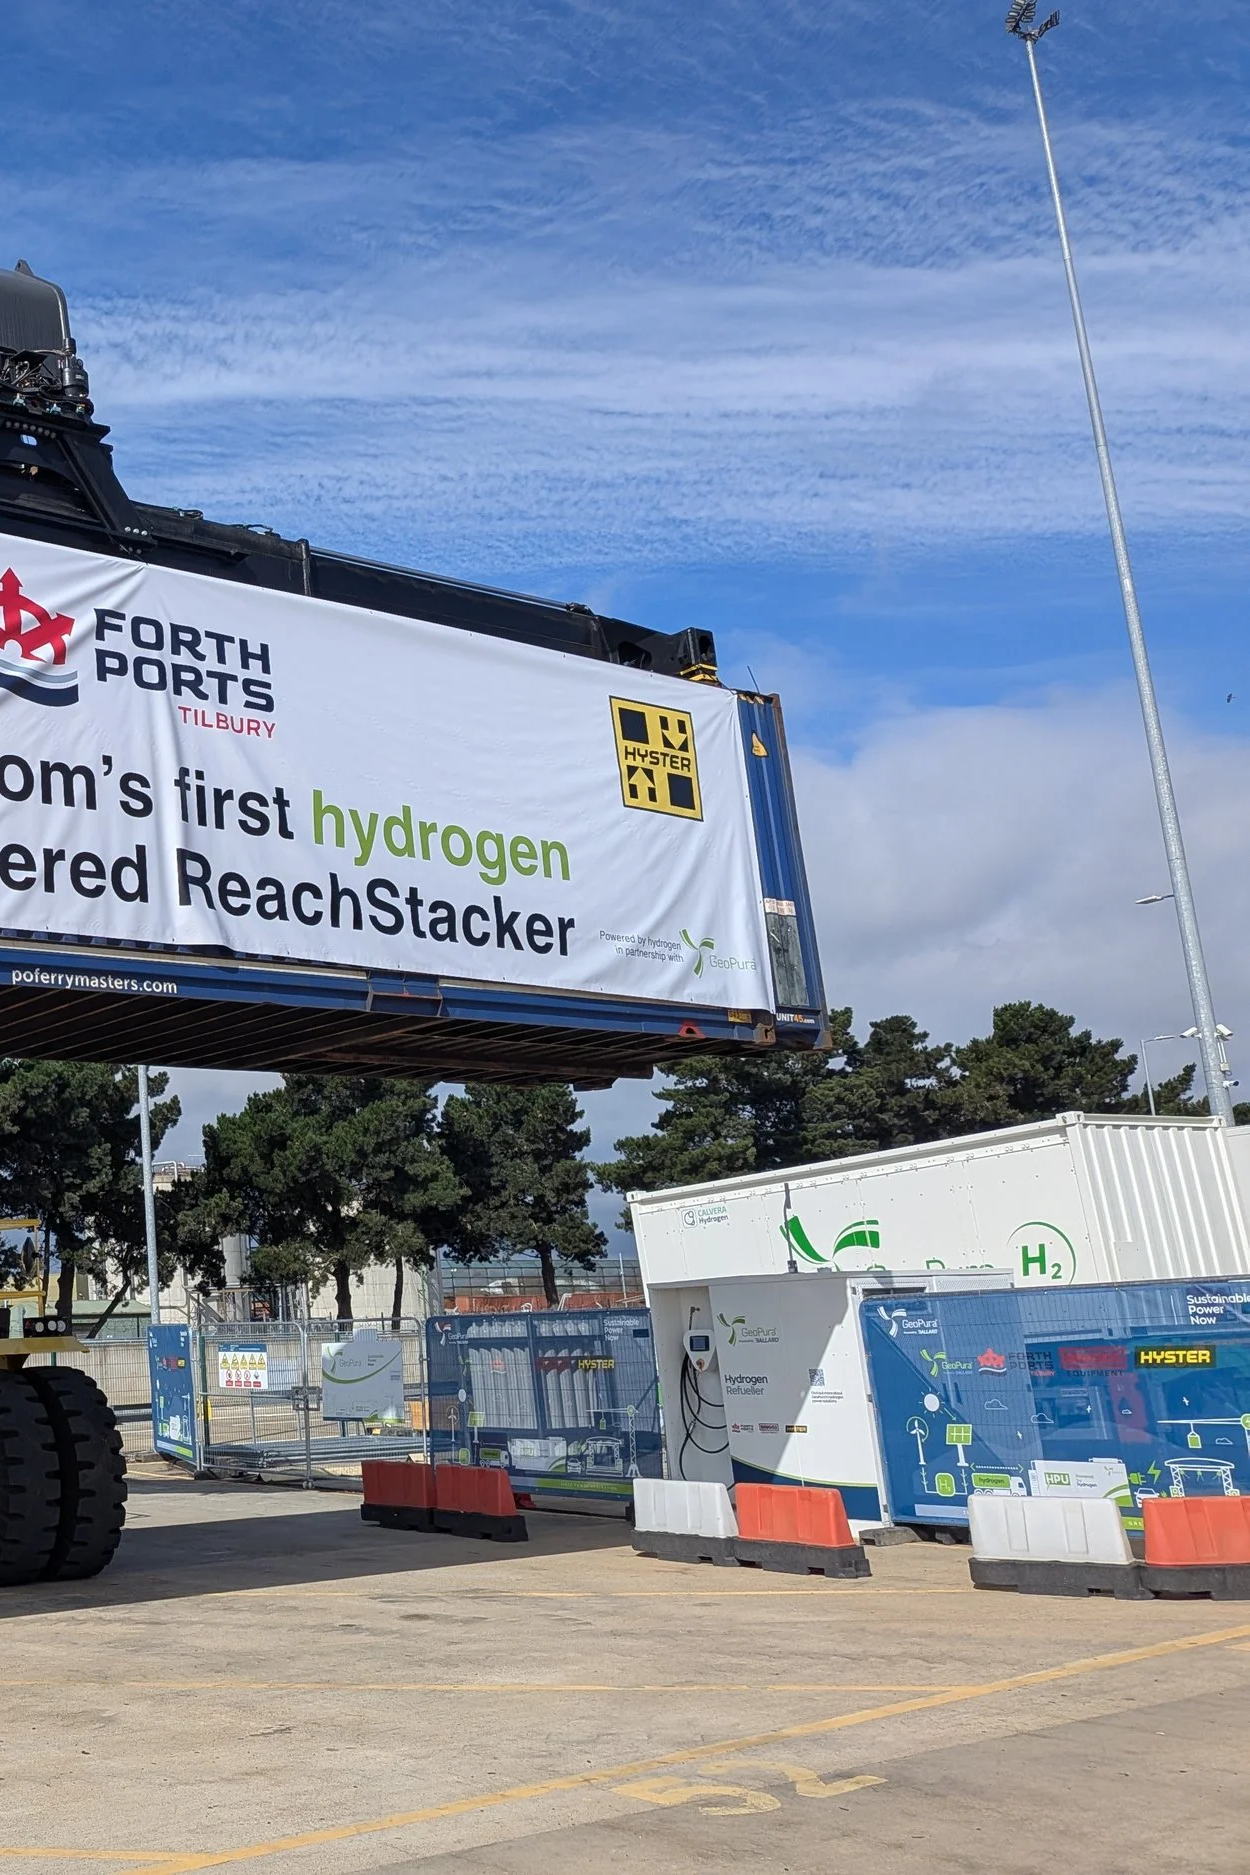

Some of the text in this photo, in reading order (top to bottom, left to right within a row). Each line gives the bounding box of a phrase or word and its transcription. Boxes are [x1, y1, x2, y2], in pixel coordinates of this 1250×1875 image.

[96, 608, 271, 675] FORTH
[97, 648, 274, 713] PORTS
[178, 706, 277, 739] TILBURY
[624, 745, 692, 774] HYSTER
[175, 766, 295, 841] first
[313, 789, 571, 886] hydrogen
[177, 847, 577, 957] ReachStacker
[600, 931, 682, 951] Powered by hydrogen
[615, 945, 684, 963] in partnership with
[709, 955, 757, 971] GeoPura
[11, 967, 178, 994] poferrymasters.com
[697, 1206, 727, 1217] CALVERA
[699, 1214, 729, 1225] Hydrogen
[1189, 1305, 1224, 1315] Power
[603, 1319, 640, 1327] Sustainable
[902, 1318, 938, 1329] GeoPura
[1190, 1315, 1216, 1325] Now
[604, 1327, 623, 1335] Power
[741, 1327, 777, 1337] GeoPura
[1140, 1350, 1211, 1364] HYSTER
[578, 1359, 615, 1369] HYSTER
[724, 1374, 768, 1385] Hydrogen
[726, 1385, 764, 1396] Refueller
[1046, 1473, 1069, 1484] HPU
